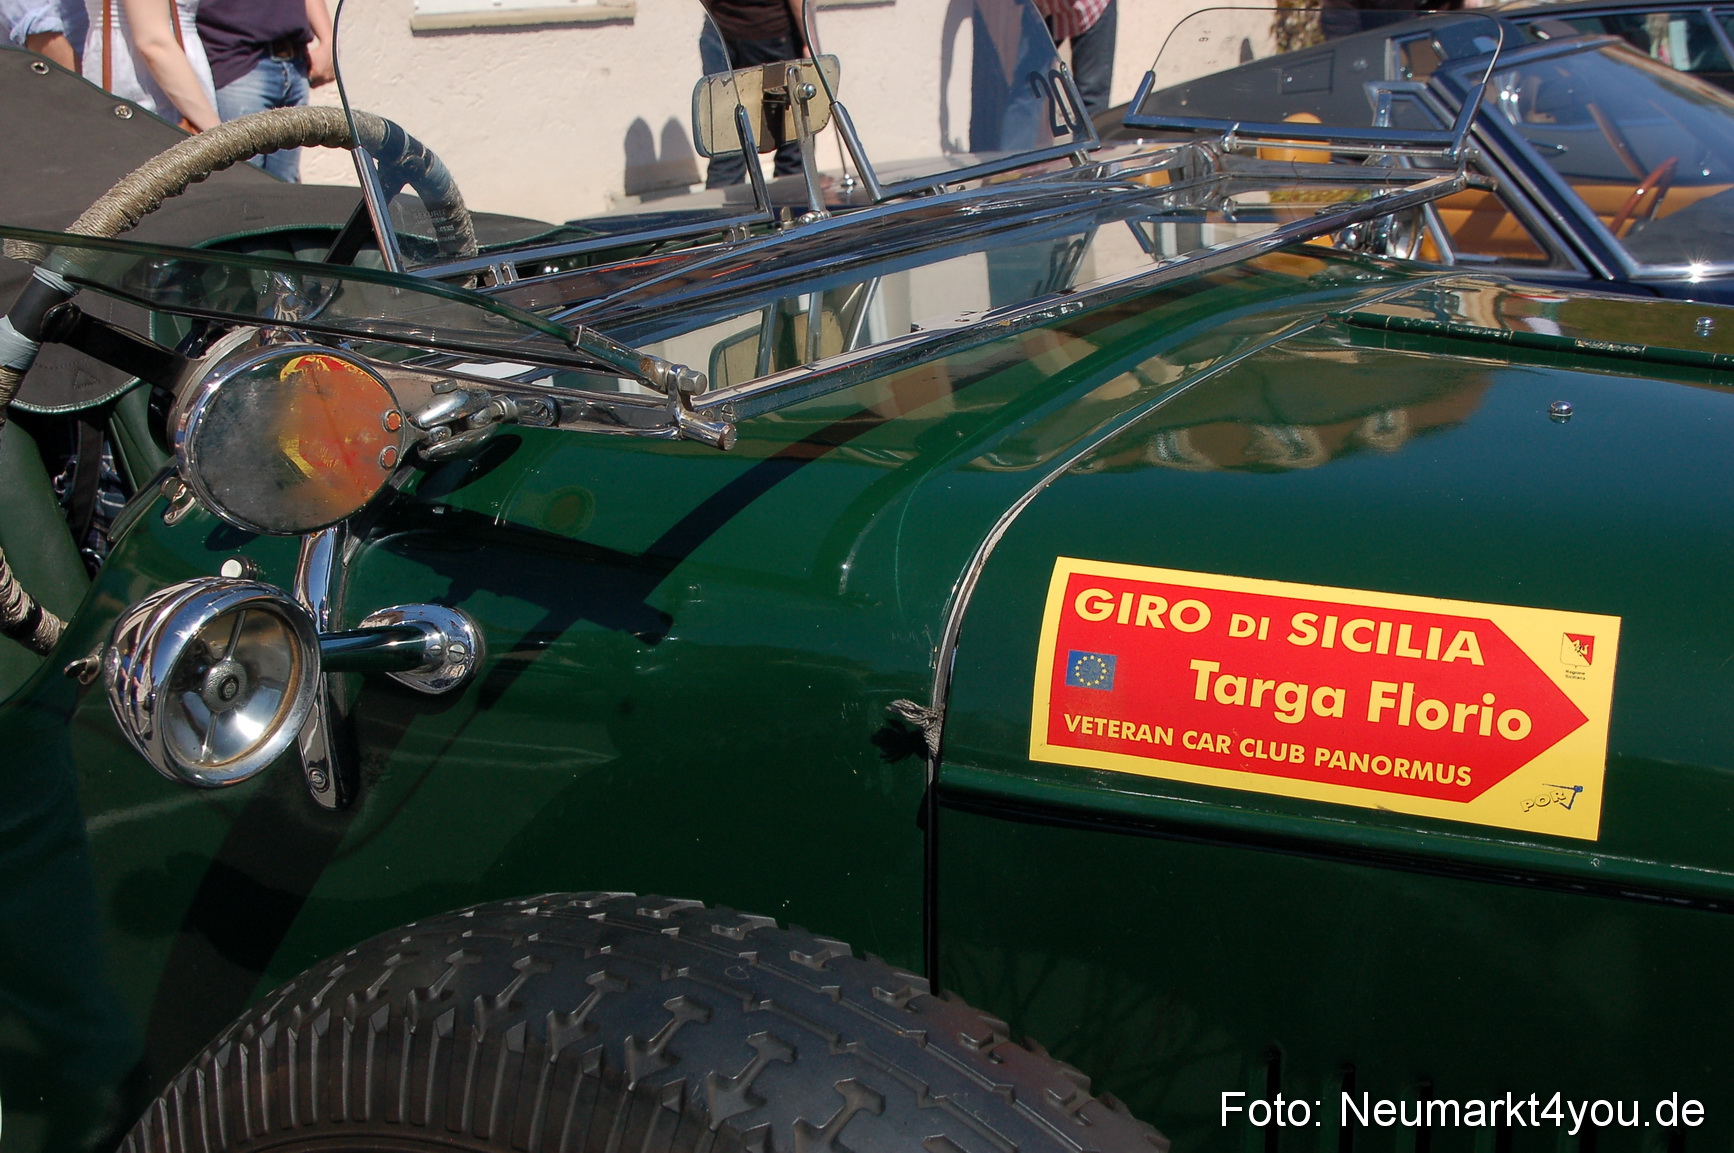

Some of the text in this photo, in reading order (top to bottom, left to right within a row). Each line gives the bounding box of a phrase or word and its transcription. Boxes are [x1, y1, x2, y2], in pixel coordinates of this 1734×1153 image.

[1029, 69, 1088, 137] 20
[1074, 588, 1485, 666] GIRO DI SICILIA
[1189, 658, 1532, 741] Targa Florio
[1063, 713, 1472, 787] VETERAN CAR CLUB PANORMUS
